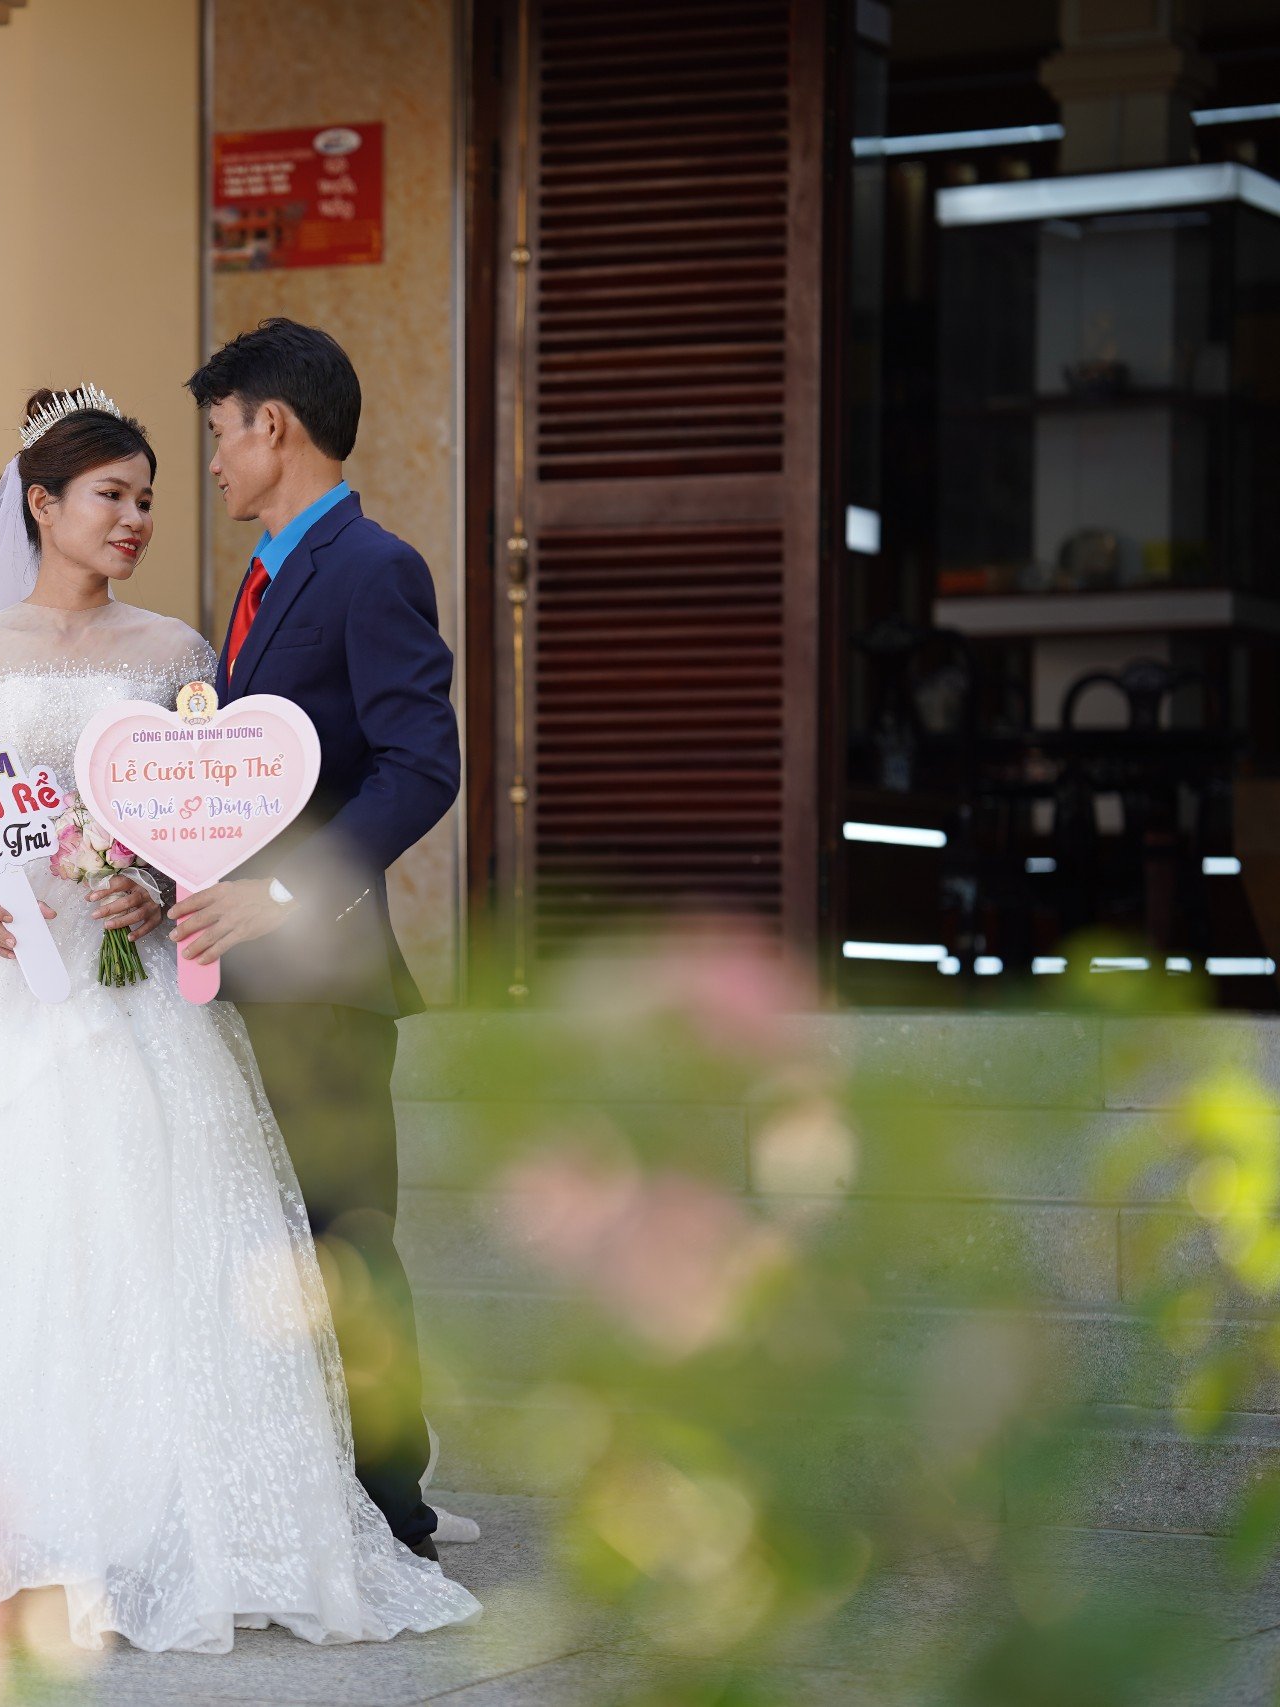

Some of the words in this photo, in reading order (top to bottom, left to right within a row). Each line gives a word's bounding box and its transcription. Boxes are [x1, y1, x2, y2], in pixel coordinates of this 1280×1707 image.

[132, 730, 161, 743] CÔNG
[165, 728, 194, 741] ĐOÀN
[227, 726, 263, 739] DƯƠNG
[111, 759, 137, 782] Lễ
[143, 760, 195, 782] Cưới
[200, 759, 237, 787] Tập
[242, 754, 284, 778] Thể
[11, 771, 60, 814] Rể
[255, 795, 282, 816] An
[3, 821, 52, 857] Trai
[150, 828, 168, 841] 30
[179, 827, 198, 840] 06
[209, 826, 243, 839] 2024
